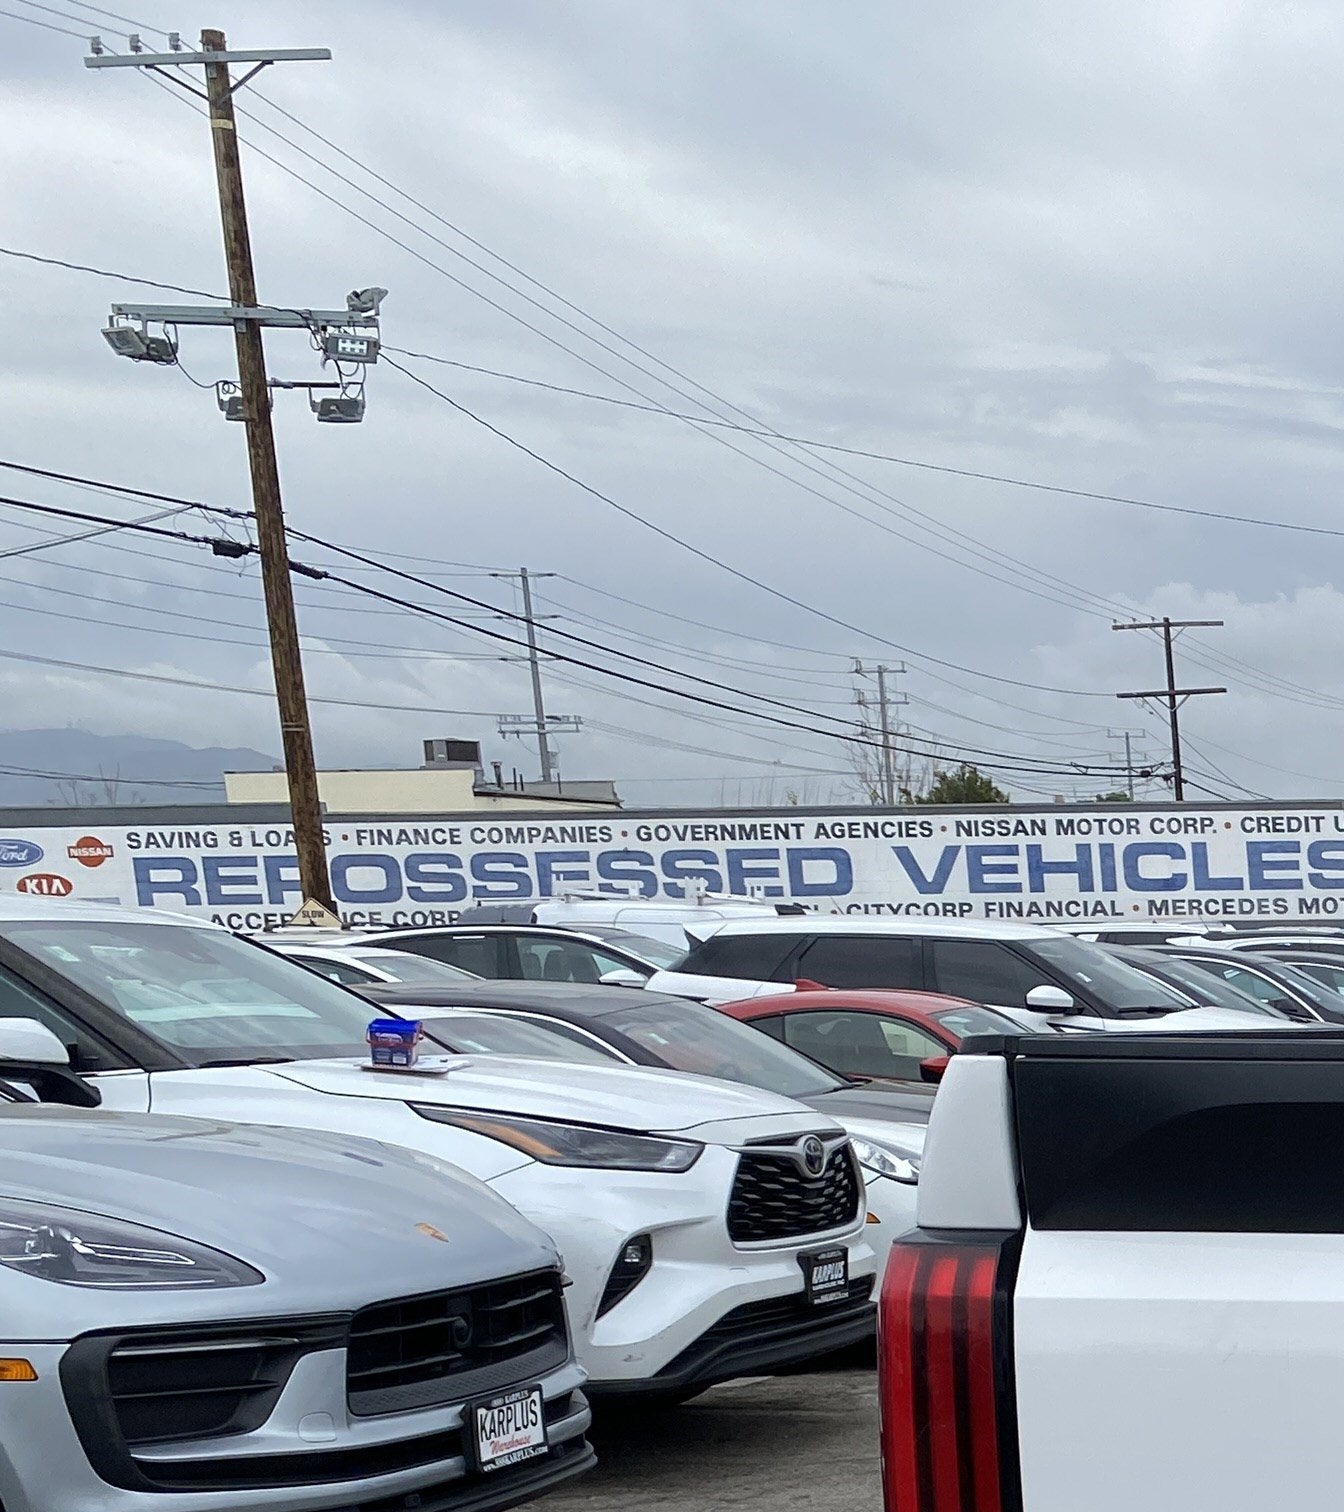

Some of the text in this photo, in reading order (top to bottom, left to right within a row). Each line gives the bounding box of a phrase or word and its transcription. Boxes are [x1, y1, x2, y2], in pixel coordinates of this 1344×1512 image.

[126, 831, 217, 849] SAVING
[228, 831, 243, 847] &
[250, 830, 332, 847] LOAS
[356, 827, 461, 846] FINANCE
[470, 825, 613, 845] COMPANIES
[636, 822, 805, 842] GOVERNMENT
[814, 820, 933, 840] AGENCIES
[955, 818, 1047, 837] NISSAN
[1056, 817, 1141, 836] MOTOR
[1150, 816, 1217, 835] CORP.
[1240, 815, 1325, 834] CREDIT
[70, 847, 112, 857] NISSAN
[25, 878, 66, 894] KIA
[302, 910, 325, 918] SLOW
[847, 902, 973, 917] CITYCORP
[985, 900, 1124, 918] FINANCIAL
[1147, 898, 1288, 917] MERCEDES
[480, 1399, 538, 1442] KARPLUS
